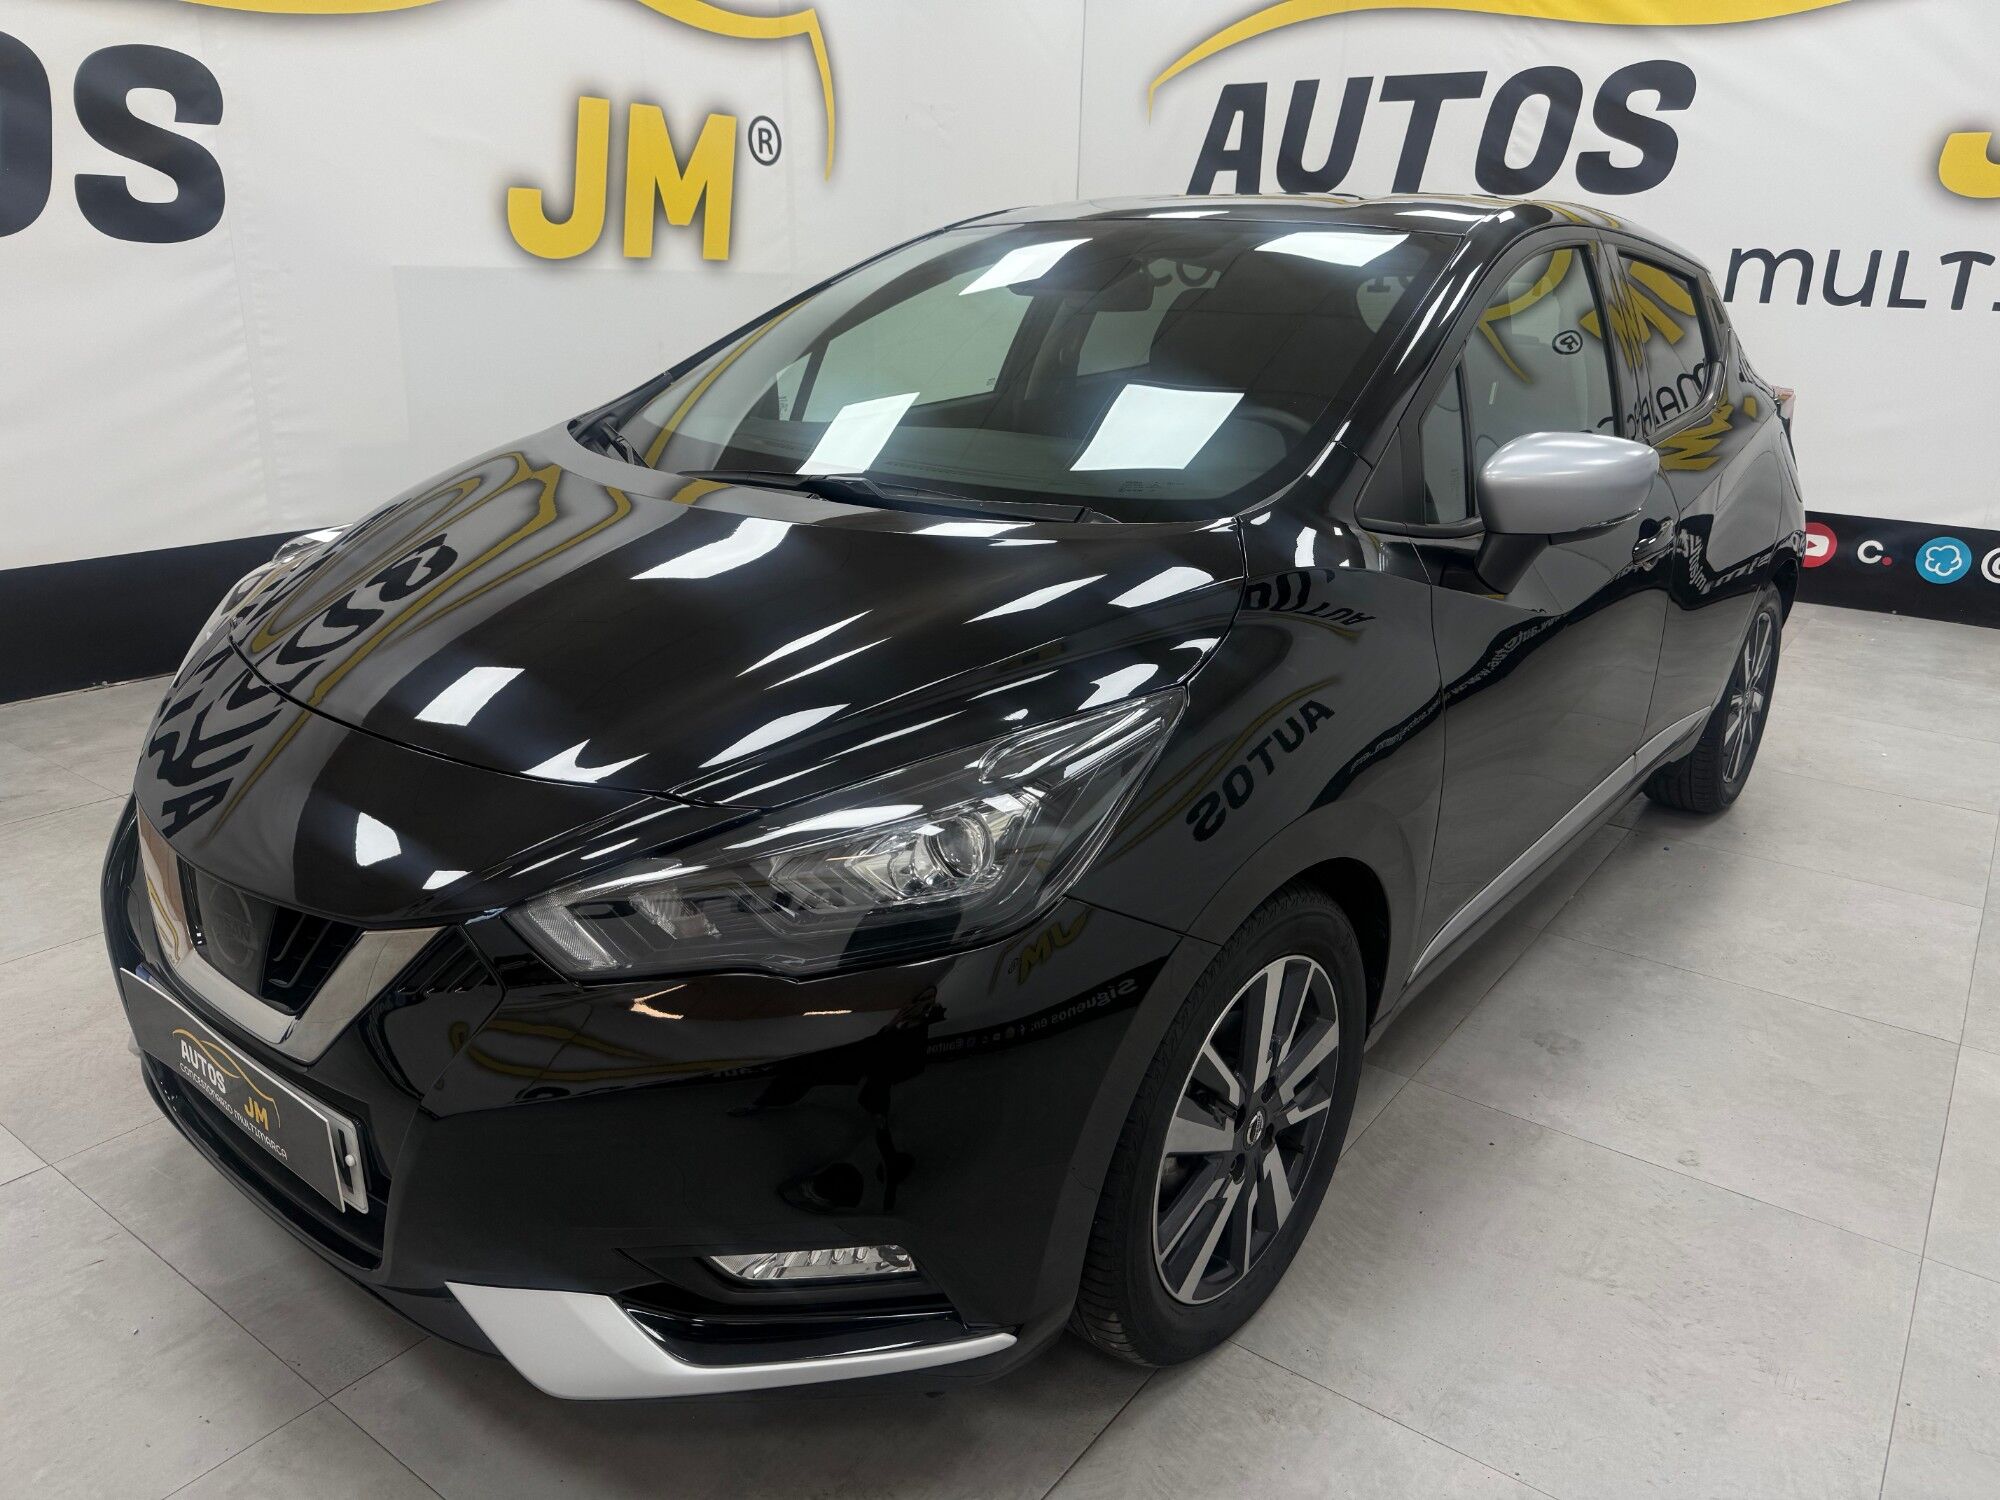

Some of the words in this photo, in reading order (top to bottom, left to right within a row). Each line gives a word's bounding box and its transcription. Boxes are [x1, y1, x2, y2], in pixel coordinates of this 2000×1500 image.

[1186, 60, 1697, 195] AUTOS
[181, 1039, 226, 1094] AUTOS
[244, 1096, 269, 1131] JM
